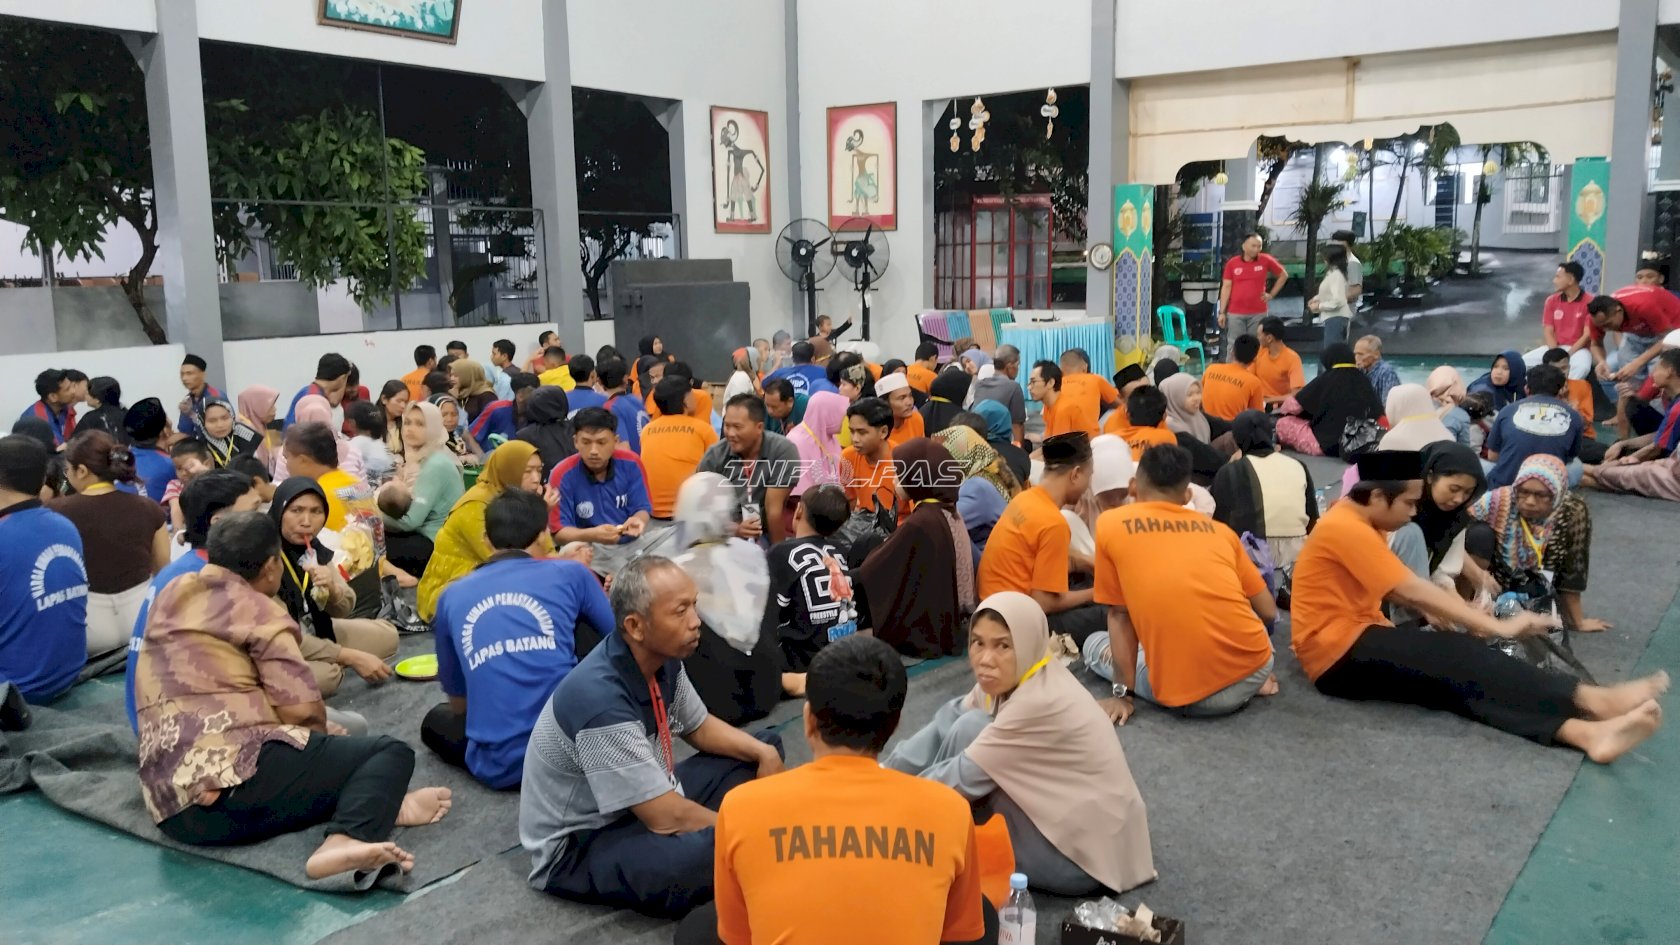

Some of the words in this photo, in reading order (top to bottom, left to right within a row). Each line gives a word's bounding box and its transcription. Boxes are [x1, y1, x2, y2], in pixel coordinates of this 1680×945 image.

[1122, 516, 1216, 535] TAHANAN
[468, 640, 504, 671] LAPAS
[505, 636, 556, 653] BATANG
[769, 825, 935, 867] TAHANAN
